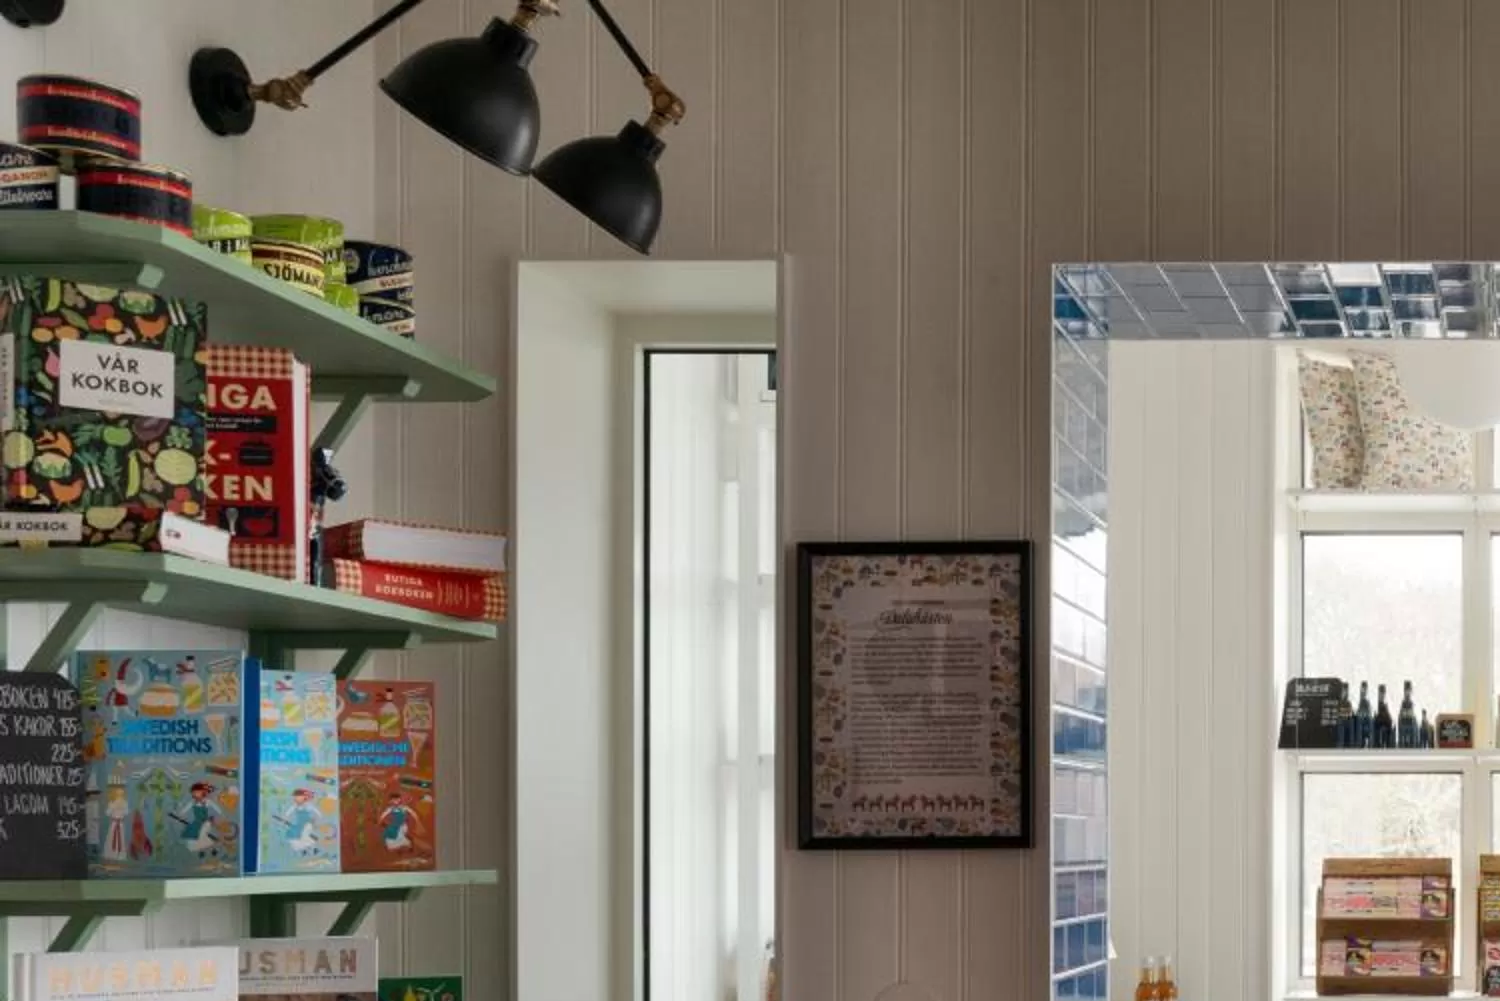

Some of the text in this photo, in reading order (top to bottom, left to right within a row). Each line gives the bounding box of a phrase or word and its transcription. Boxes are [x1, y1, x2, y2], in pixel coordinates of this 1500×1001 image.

[97, 354, 139, 373] VÅR
[72, 372, 163, 398] KOKBOK
[206, 383, 277, 411] IGA
[16, 520, 68, 532] KOKBOK
[383, 573, 423, 587] RUTIGA
[375, 585, 434, 600] KOKBOKEN
[121, 719, 199, 735] EDISH
[107, 736, 212, 754] TDITIONS
[4, 792, 49, 815] LAGOM
[49, 958, 218, 994] HUSMAN
